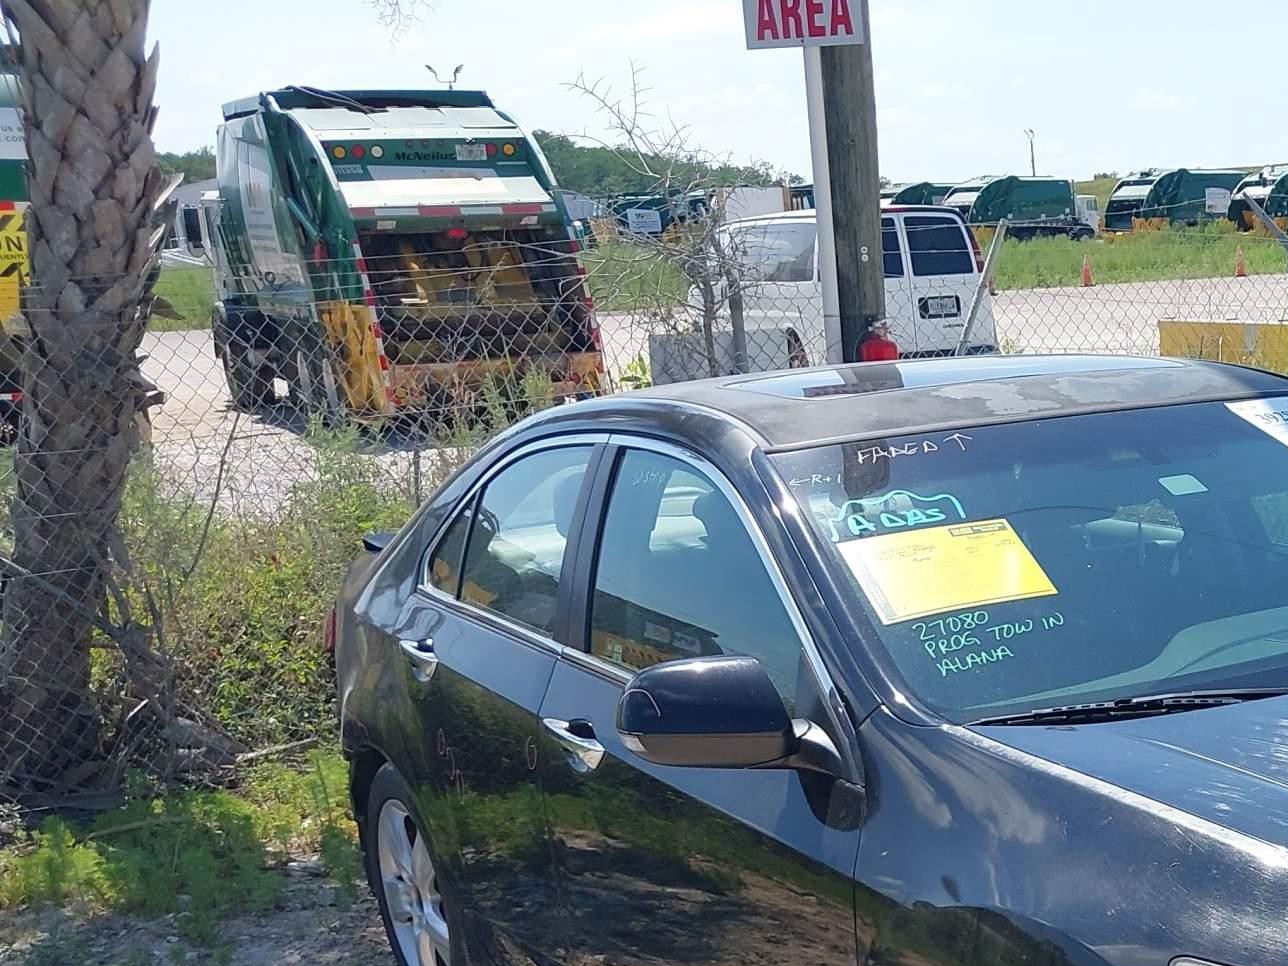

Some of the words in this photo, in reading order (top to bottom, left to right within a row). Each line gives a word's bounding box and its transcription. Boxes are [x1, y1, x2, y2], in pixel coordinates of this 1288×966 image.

[757, 0, 854, 41] AREA
[912, 611, 989, 640] 27080
[924, 631, 981, 659] PROG
[986, 619, 1034, 641] TOW
[1042, 612, 1064, 630] IN
